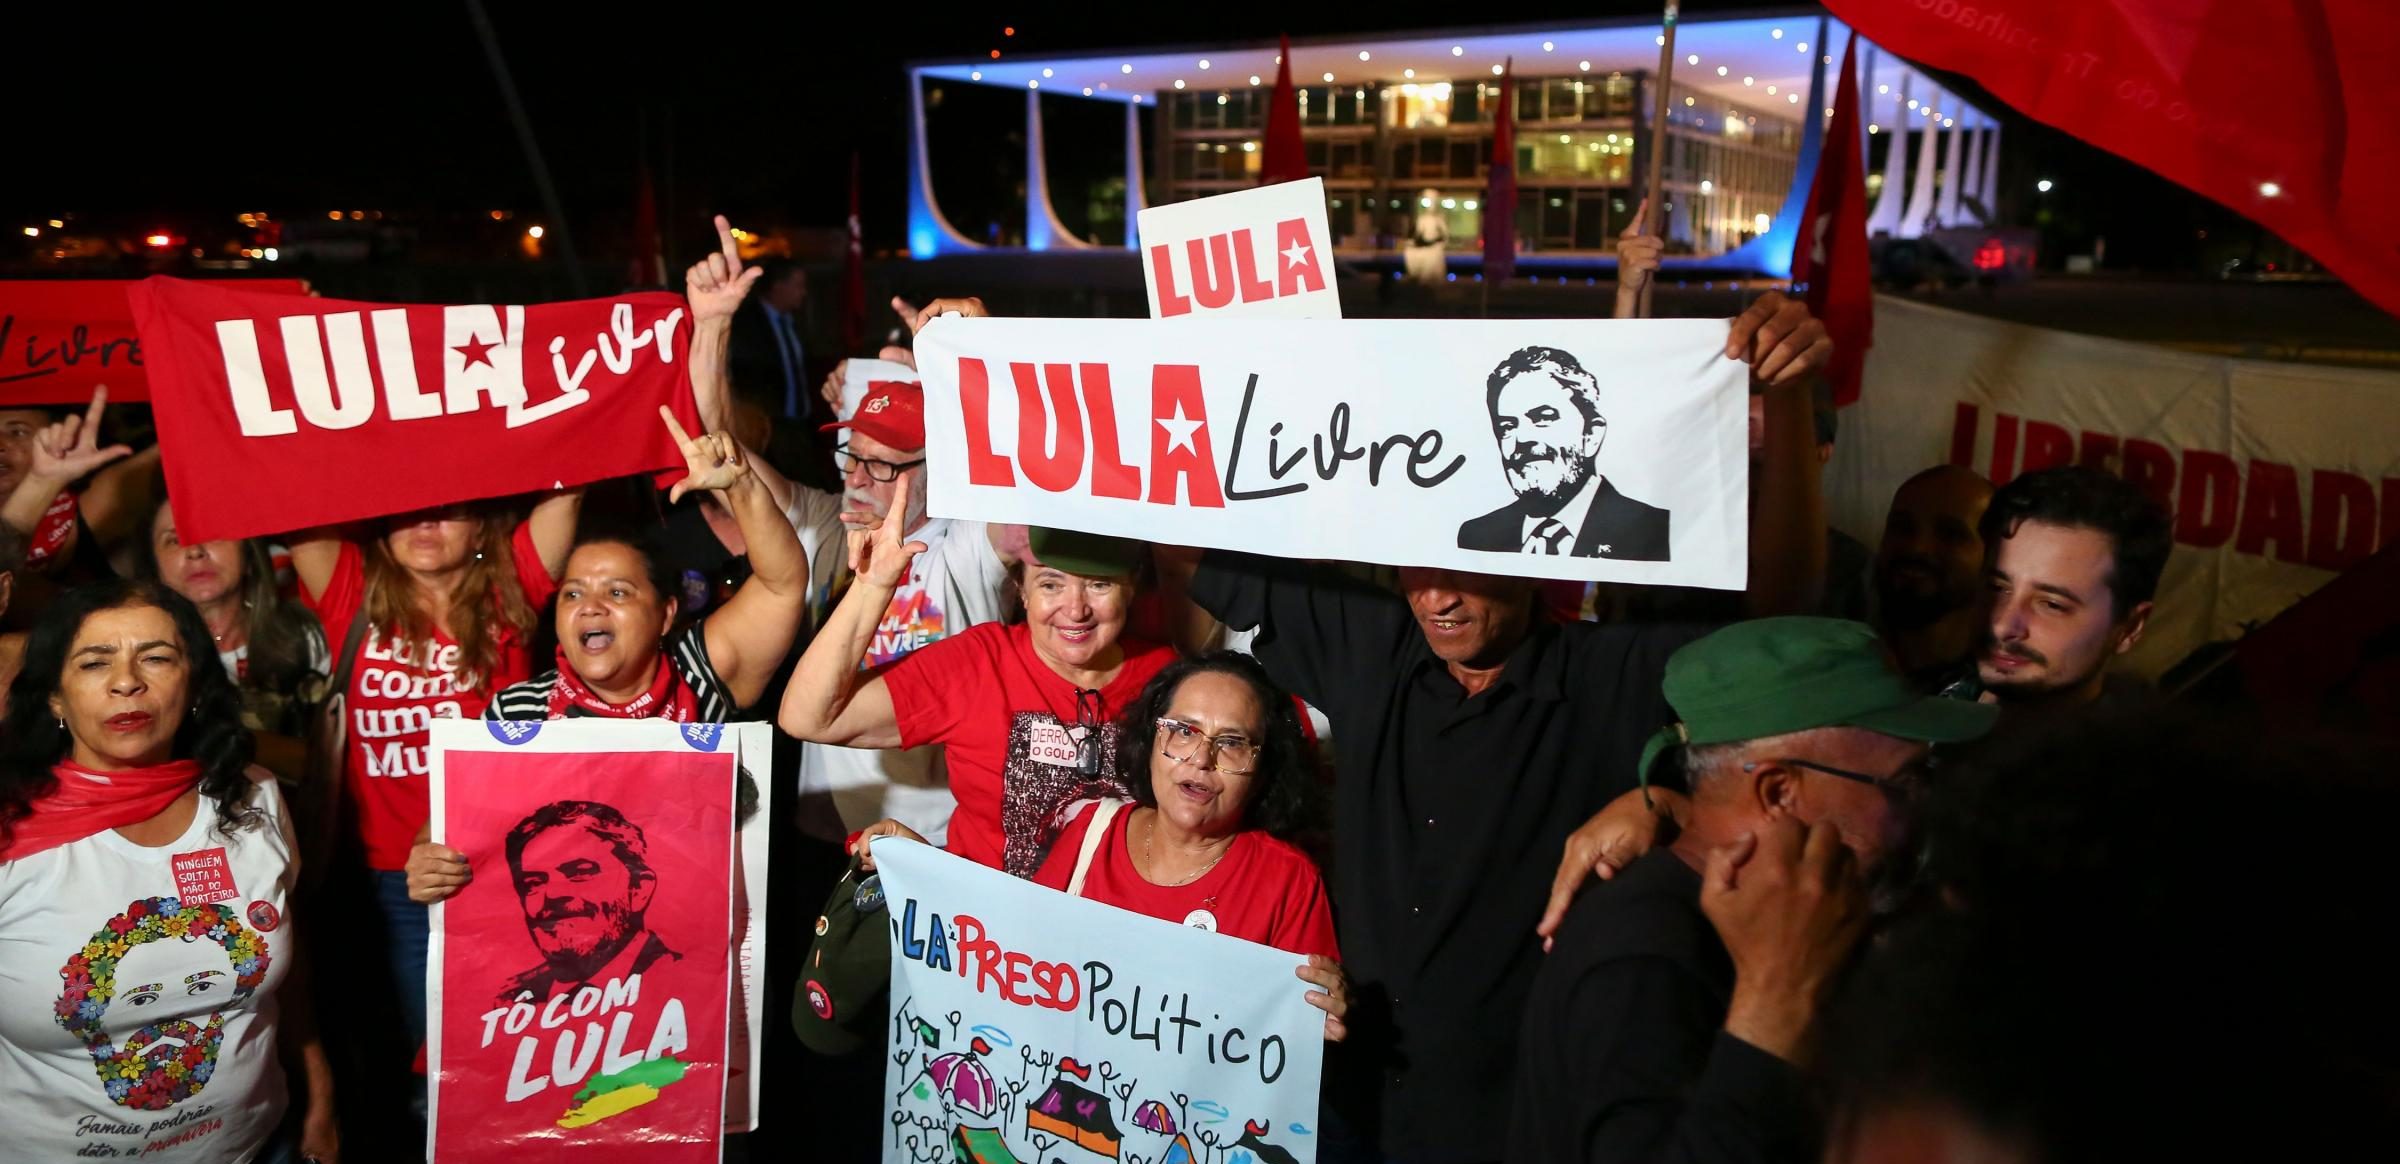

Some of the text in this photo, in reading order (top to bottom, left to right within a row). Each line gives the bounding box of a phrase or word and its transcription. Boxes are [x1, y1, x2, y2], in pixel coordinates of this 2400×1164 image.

[1150, 217, 1327, 319] LULA
[215, 303, 528, 437] LULA
[958, 357, 1467, 509] LULA Livre
[360, 667, 478, 700] como
[354, 700, 464, 739] uma
[1032, 746, 1076, 760] O GOLP
[176, 854, 222, 871] NINGUÉM
[179, 869, 221, 883] SOLTA A
[182, 881, 221, 895] MÃO DO
[185, 889, 235, 906] PORTEIRO
[953, 914, 1081, 1012] PRESO
[480, 973, 643, 1049] TÔ COM
[505, 997, 689, 1103] LULA
[75, 1104, 215, 1139] Jamais poderão
[76, 1141, 121, 1158] deter
[125, 1146, 142, 1157] a
